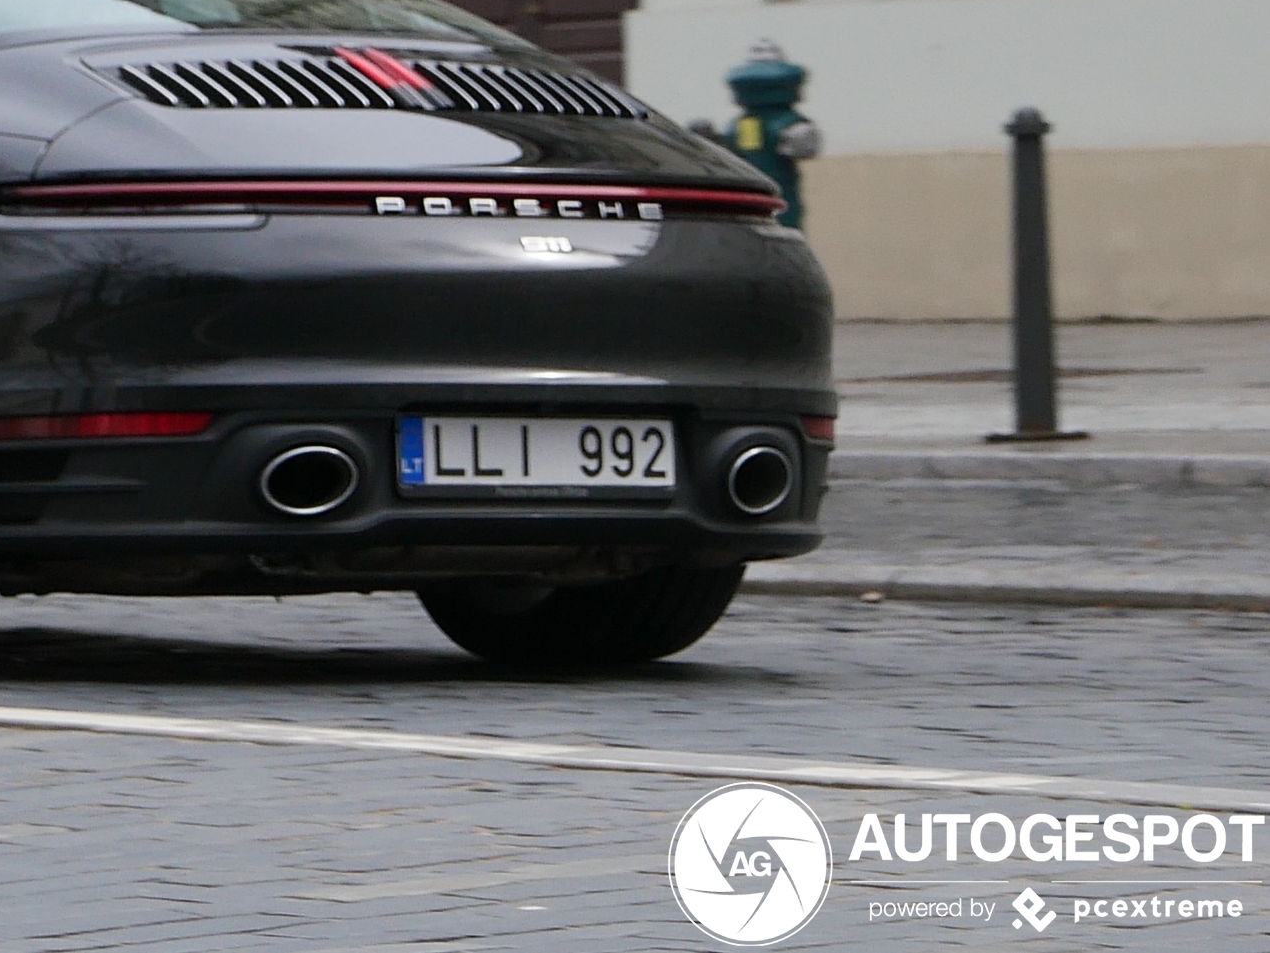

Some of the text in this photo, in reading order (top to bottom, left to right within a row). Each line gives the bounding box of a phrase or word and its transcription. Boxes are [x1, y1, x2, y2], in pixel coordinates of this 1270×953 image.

[375, 196, 664, 220] PORSCHE
[433, 424, 667, 478] LLI 992
[401, 458, 422, 474] LT
